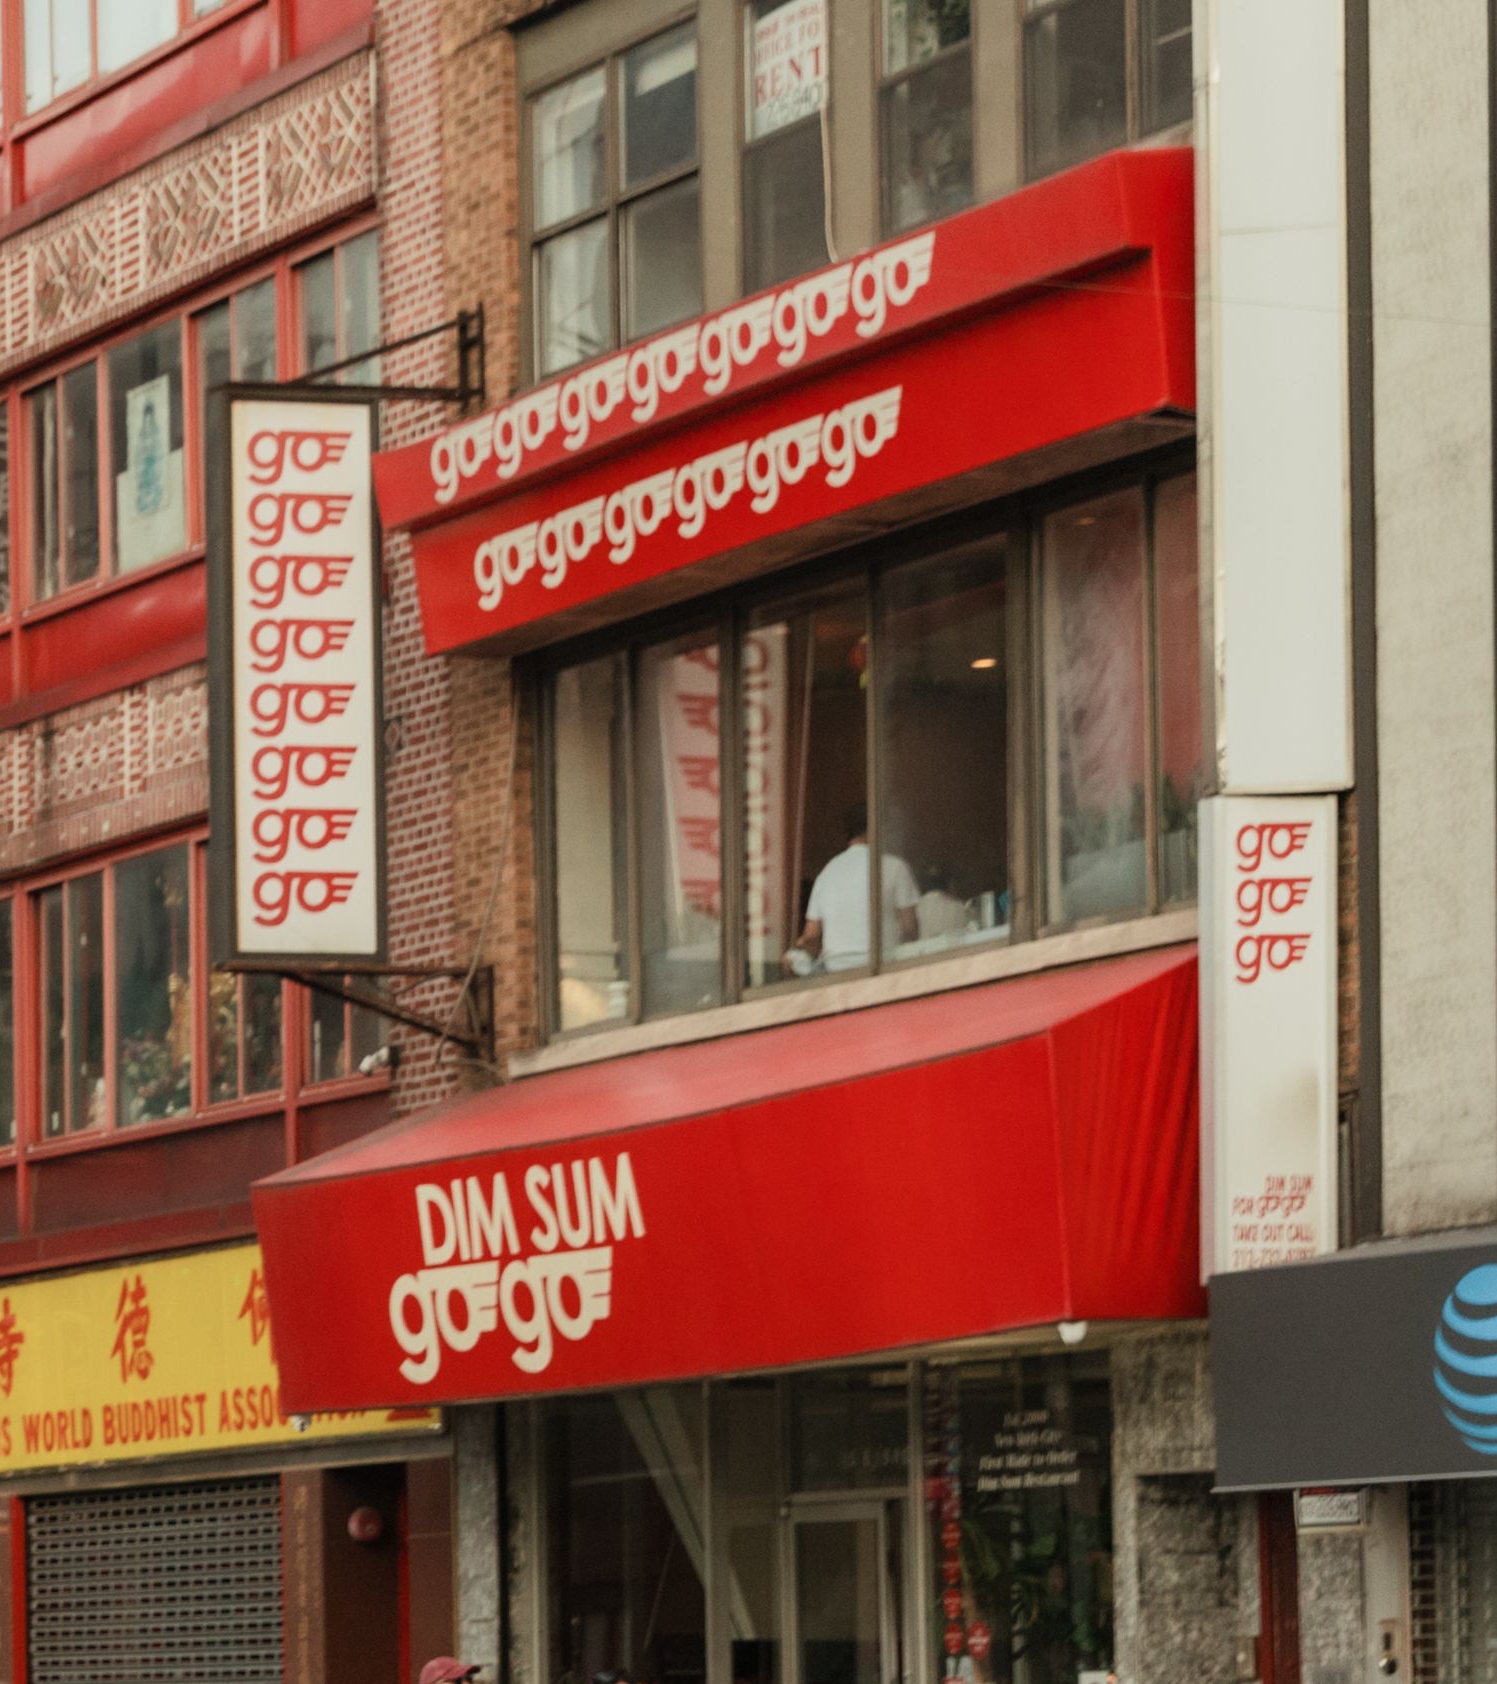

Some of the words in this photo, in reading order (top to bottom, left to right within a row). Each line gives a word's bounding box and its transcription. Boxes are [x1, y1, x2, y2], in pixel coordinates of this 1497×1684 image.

[755, 43, 821, 109] RENT
[247, 430, 354, 485] go
[248, 492, 355, 547] go
[249, 554, 356, 609] go
[250, 618, 357, 673] go
[251, 683, 358, 737] go
[251, 745, 358, 800] go
[252, 808, 359, 864] go
[1236, 821, 1313, 873] go
[253, 870, 360, 927] go
[1235, 876, 1313, 928] go
[1234, 932, 1312, 985] go
[415, 1171, 521, 1267] DIM
[524, 1151, 646, 1253] SUM
[24, 1406, 93, 1455] WORLD
[102, 1392, 208, 1445] BUDDHIST
